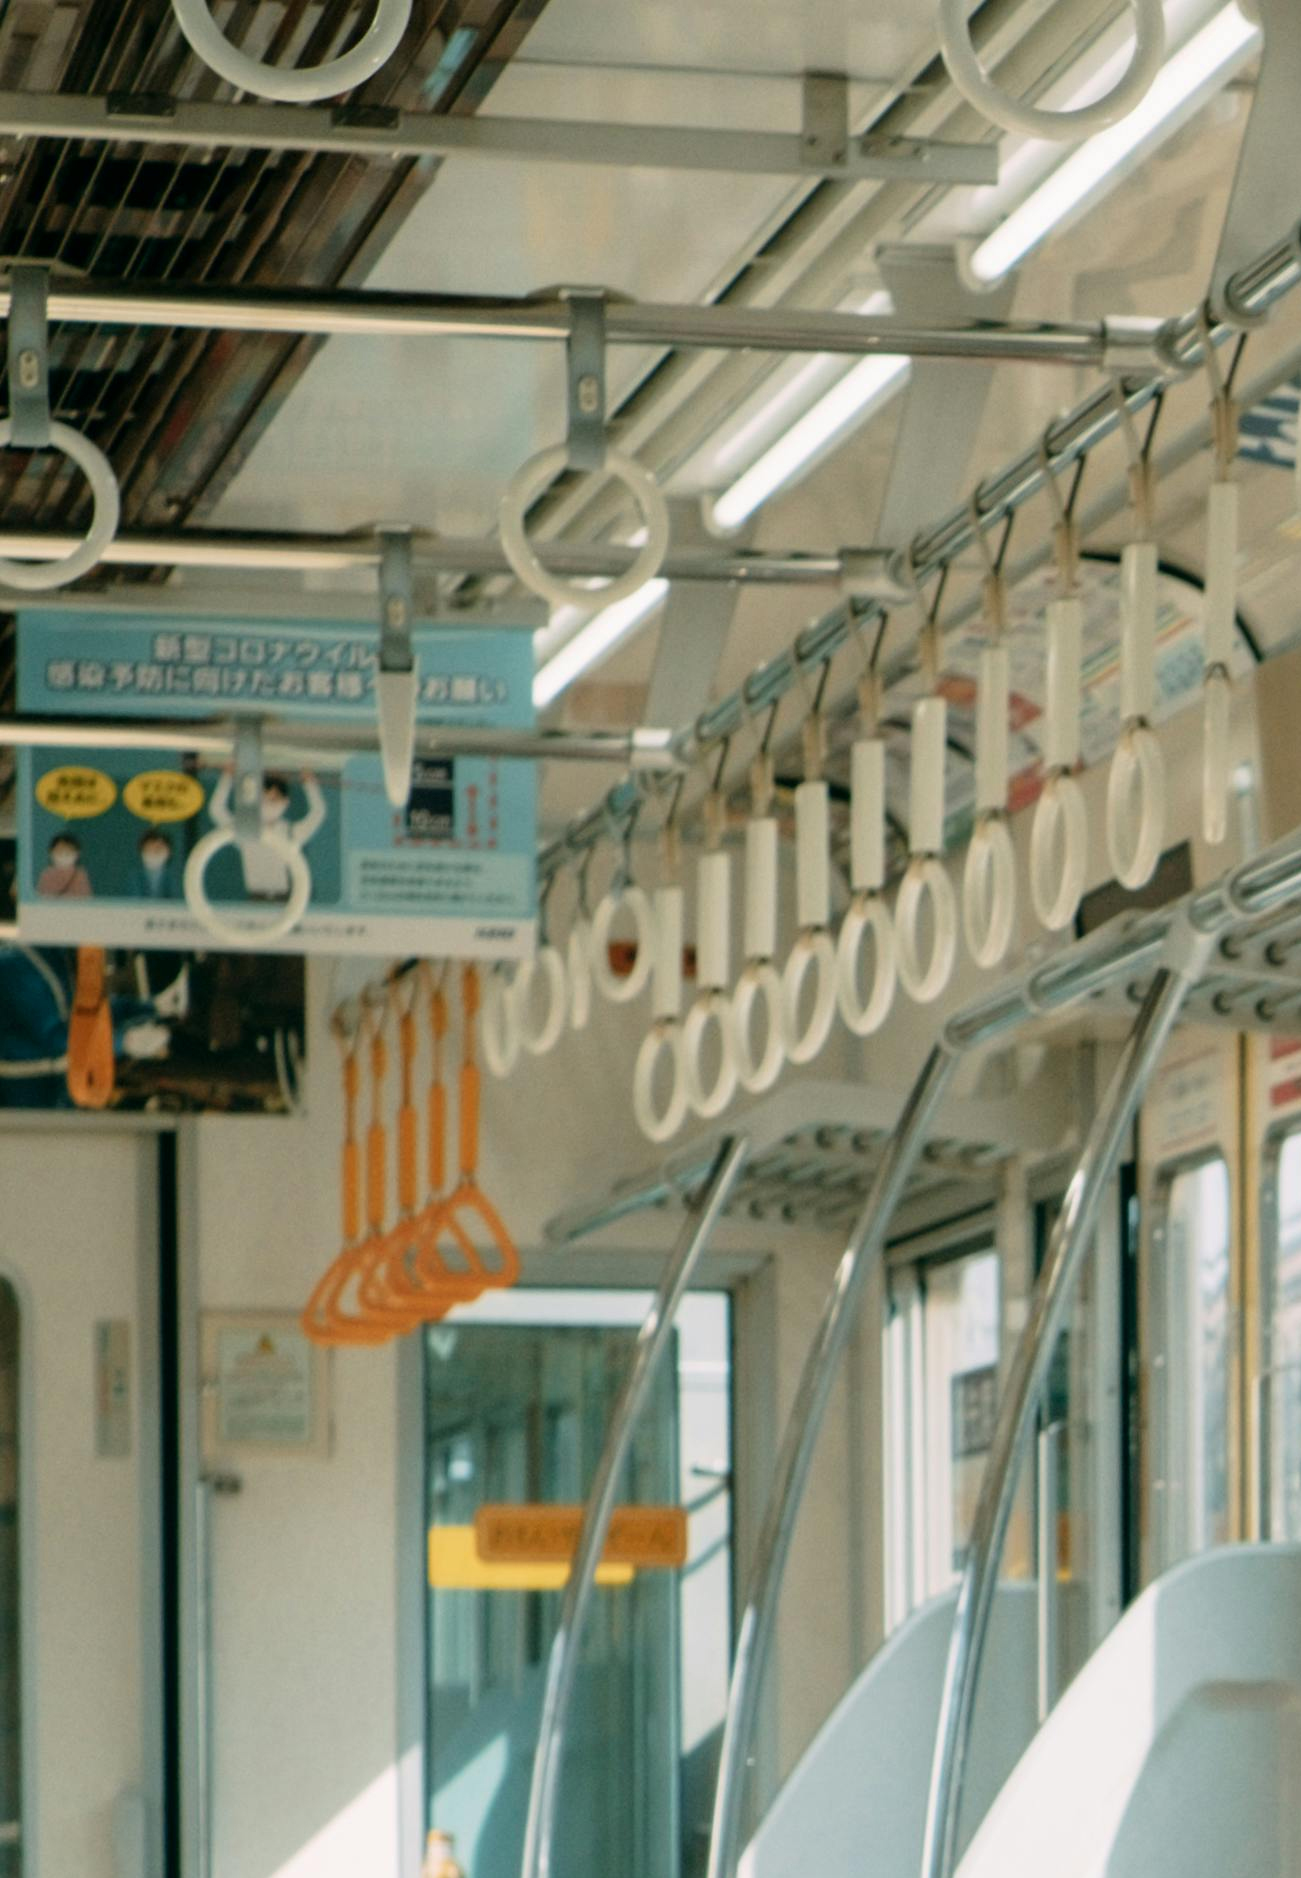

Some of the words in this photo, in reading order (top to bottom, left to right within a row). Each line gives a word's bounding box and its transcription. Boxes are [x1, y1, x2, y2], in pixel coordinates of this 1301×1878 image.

[47, 660, 508, 702] 感染予防に向けたお客様お願い
